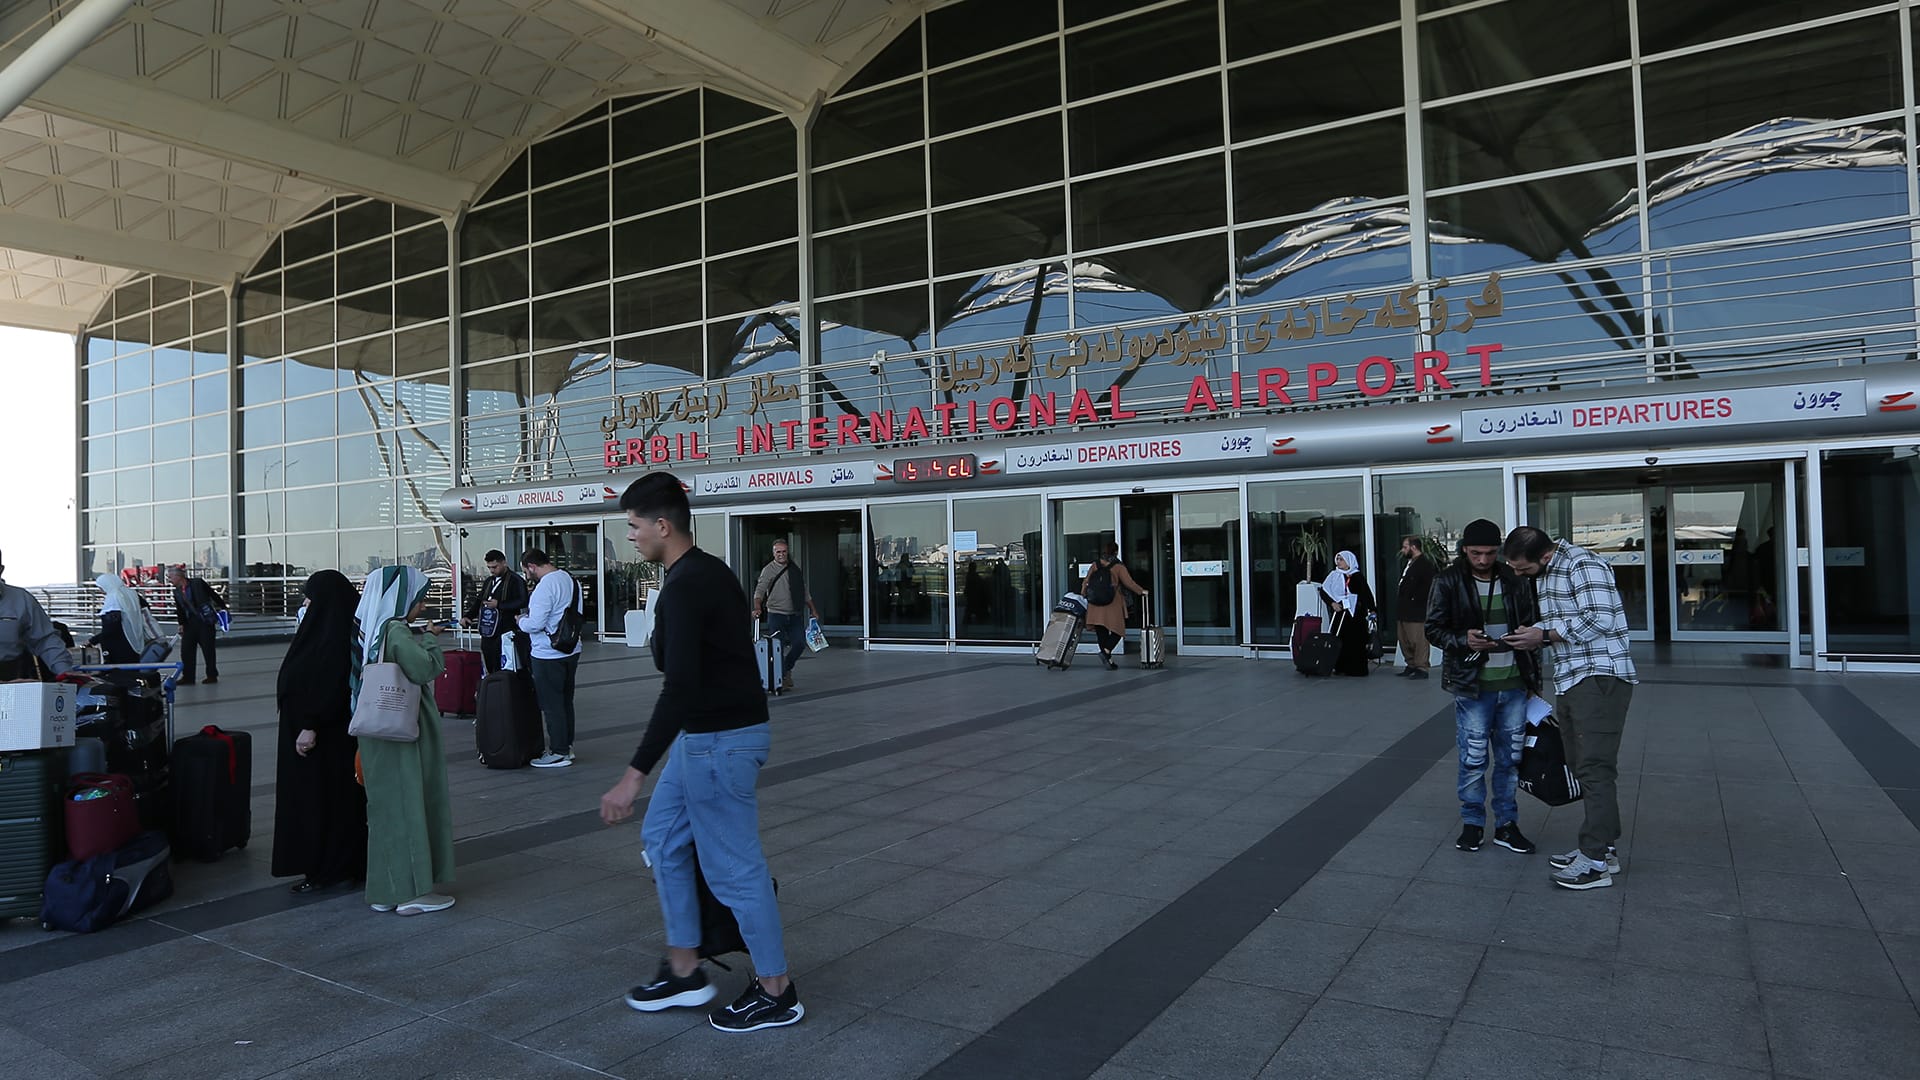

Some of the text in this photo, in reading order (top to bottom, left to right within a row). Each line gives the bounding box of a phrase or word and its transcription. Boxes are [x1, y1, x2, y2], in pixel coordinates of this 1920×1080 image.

[743, 373, 799, 415] مطار
[1794, 390, 1842, 411] چوون
[604, 343, 1503, 467] ERBIL INTERNATIONAL AIRPORT
[1572, 397, 1732, 428] DEPARTURES
[1479, 409, 1564, 434] المغادرون
[1078, 440, 1182, 463] DEPARTURES
[1221, 435, 1252, 453] چوون
[1017, 447, 1073, 468] المغادرون
[705, 477, 741, 493] القادمون
[748, 469, 814, 488] ARRIVALS
[830, 468, 855, 484] هاتن
[483, 495, 509, 508] القادمون
[517, 490, 564, 505] ARRIVALS
